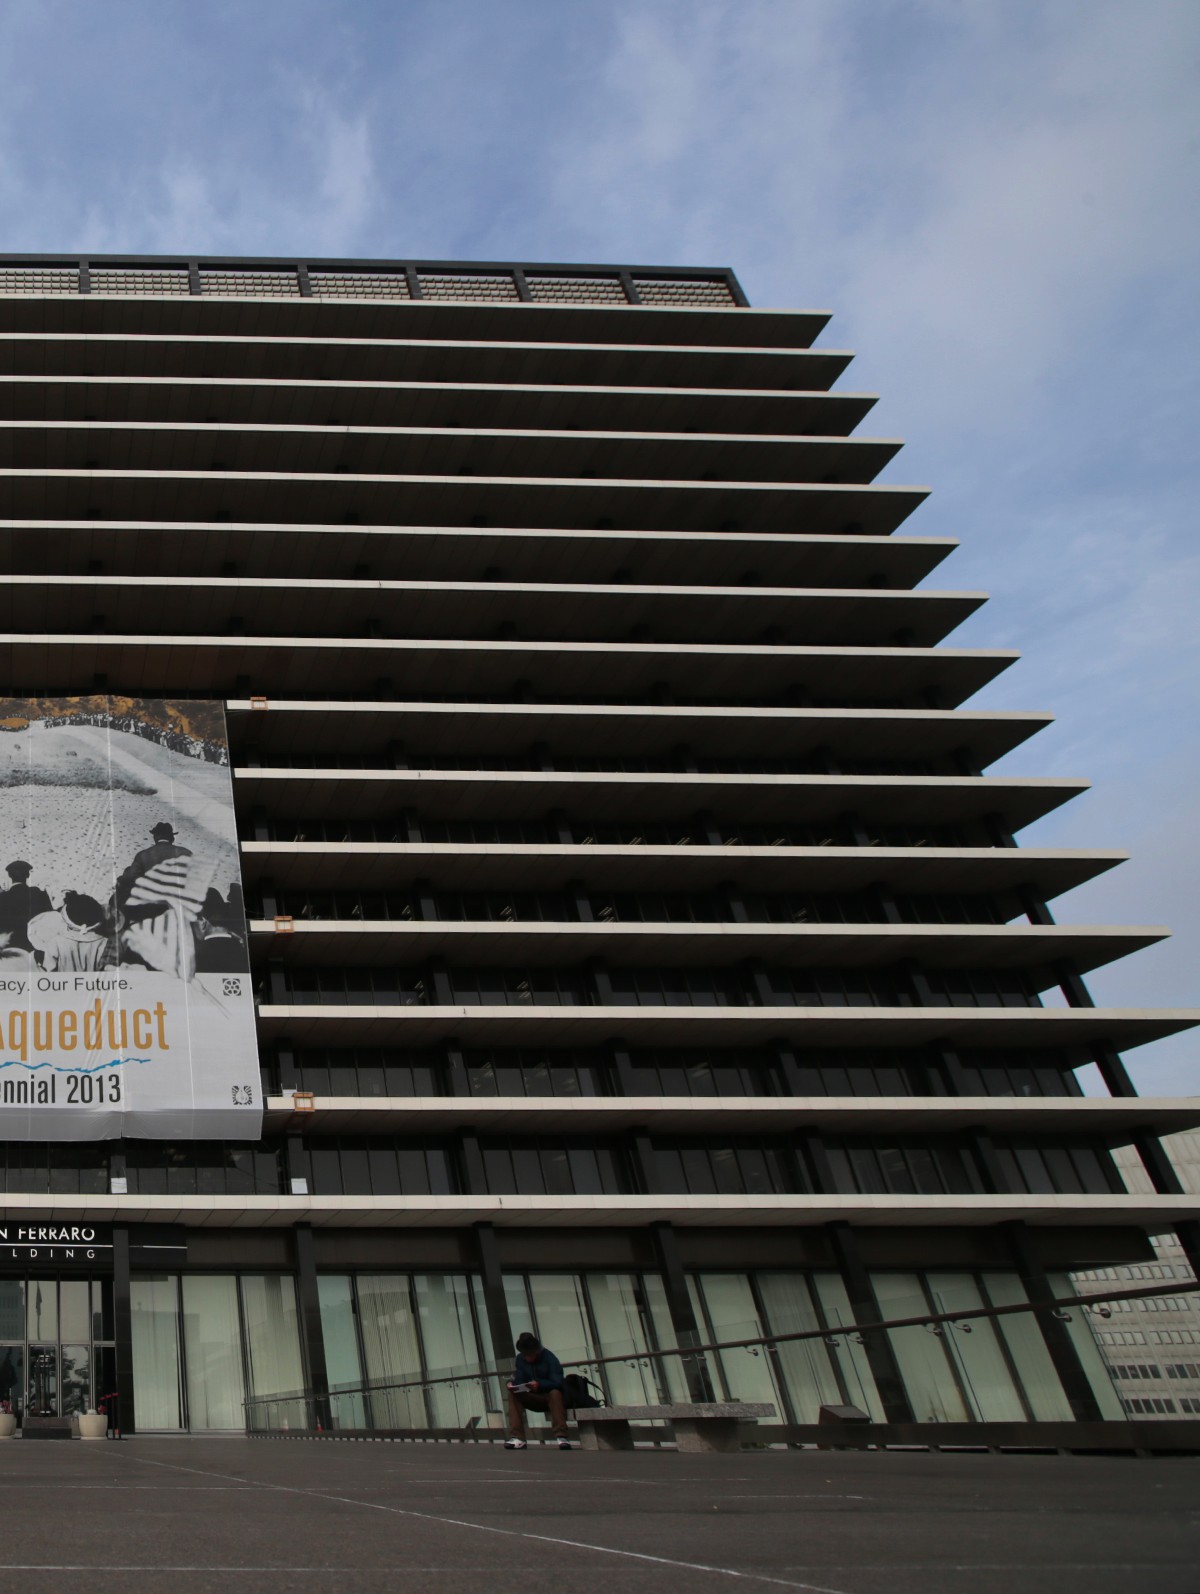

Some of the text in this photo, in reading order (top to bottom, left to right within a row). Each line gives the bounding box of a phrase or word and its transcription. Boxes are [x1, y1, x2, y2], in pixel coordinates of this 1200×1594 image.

[37, 977, 68, 992] Our
[74, 977, 133, 992] Future.
[66, 1074, 121, 1104] 2013
[18, 1226, 96, 1241] FERRARO
